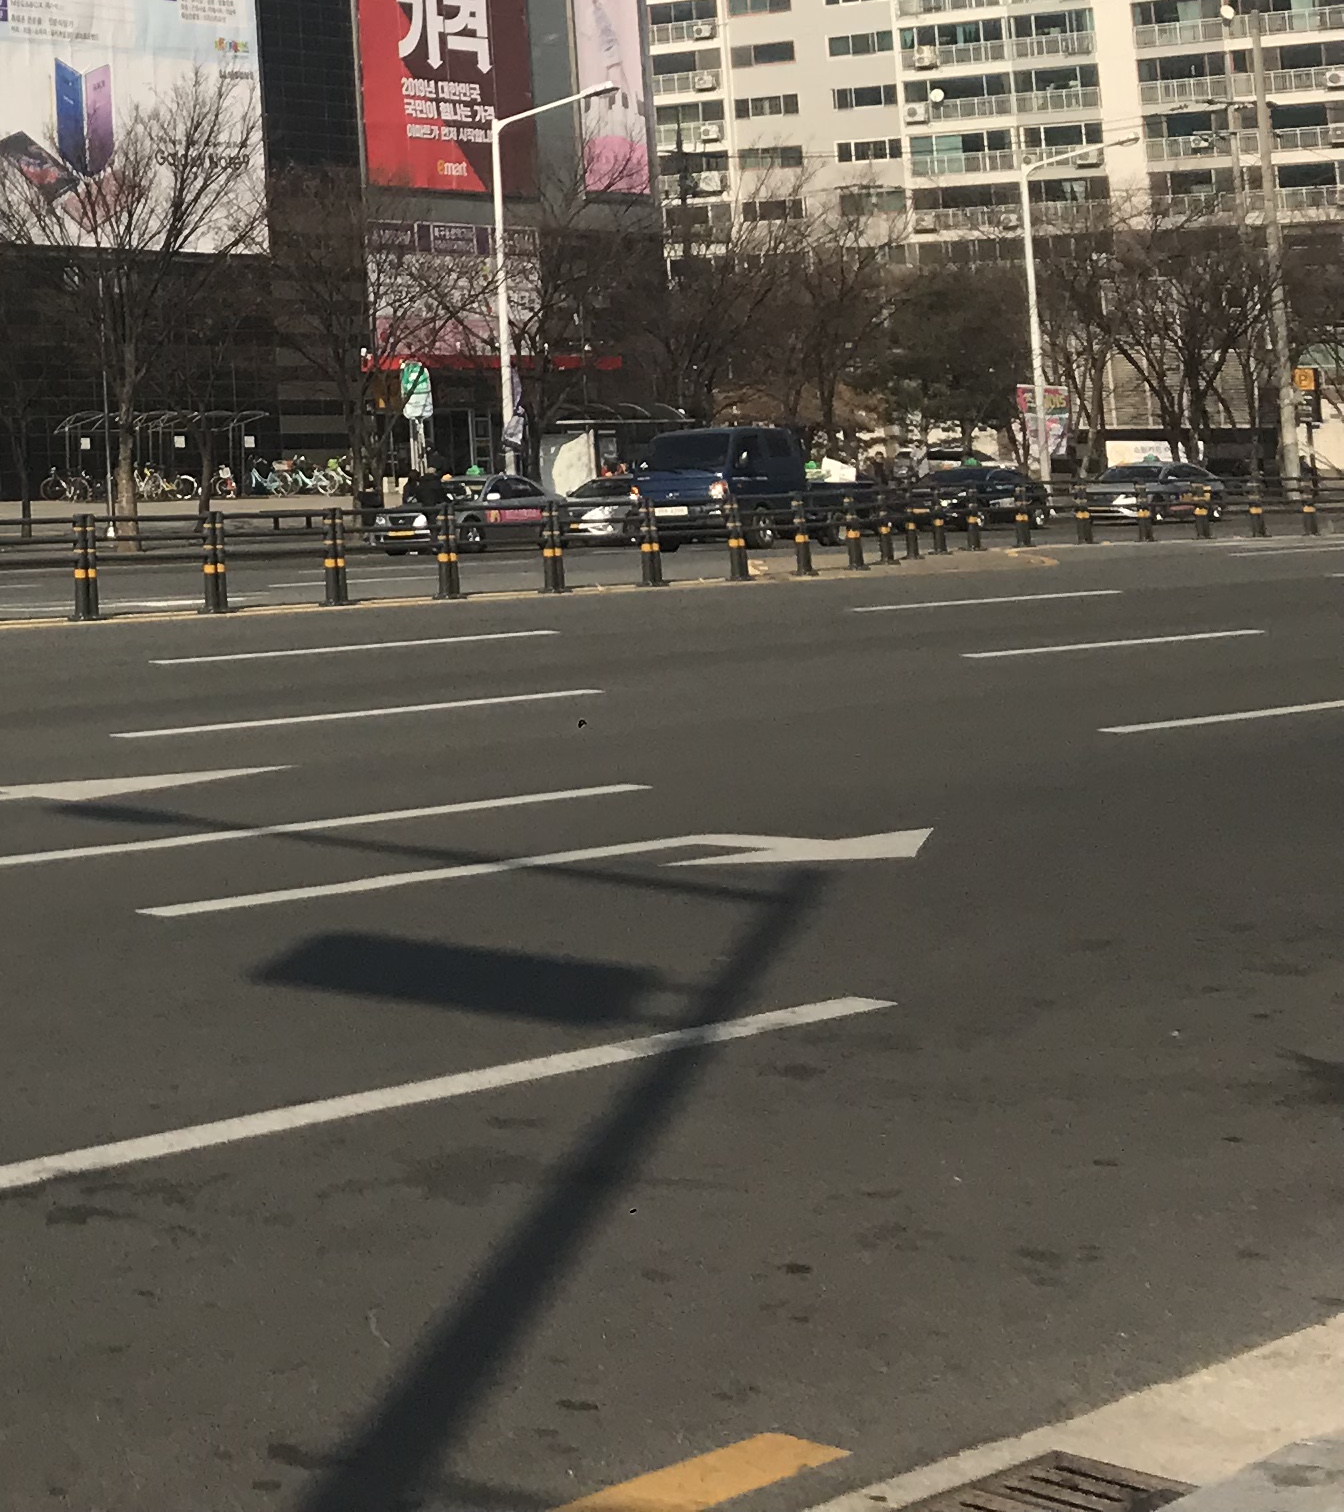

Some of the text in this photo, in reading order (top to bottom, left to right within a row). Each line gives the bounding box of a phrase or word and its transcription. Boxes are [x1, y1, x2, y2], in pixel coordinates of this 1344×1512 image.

[401, 76, 482, 103] 2019년 대한민국
[404, 98, 438, 119] 국민이
[473, 105, 495, 124] 가격
[437, 159, 468, 177] emart
